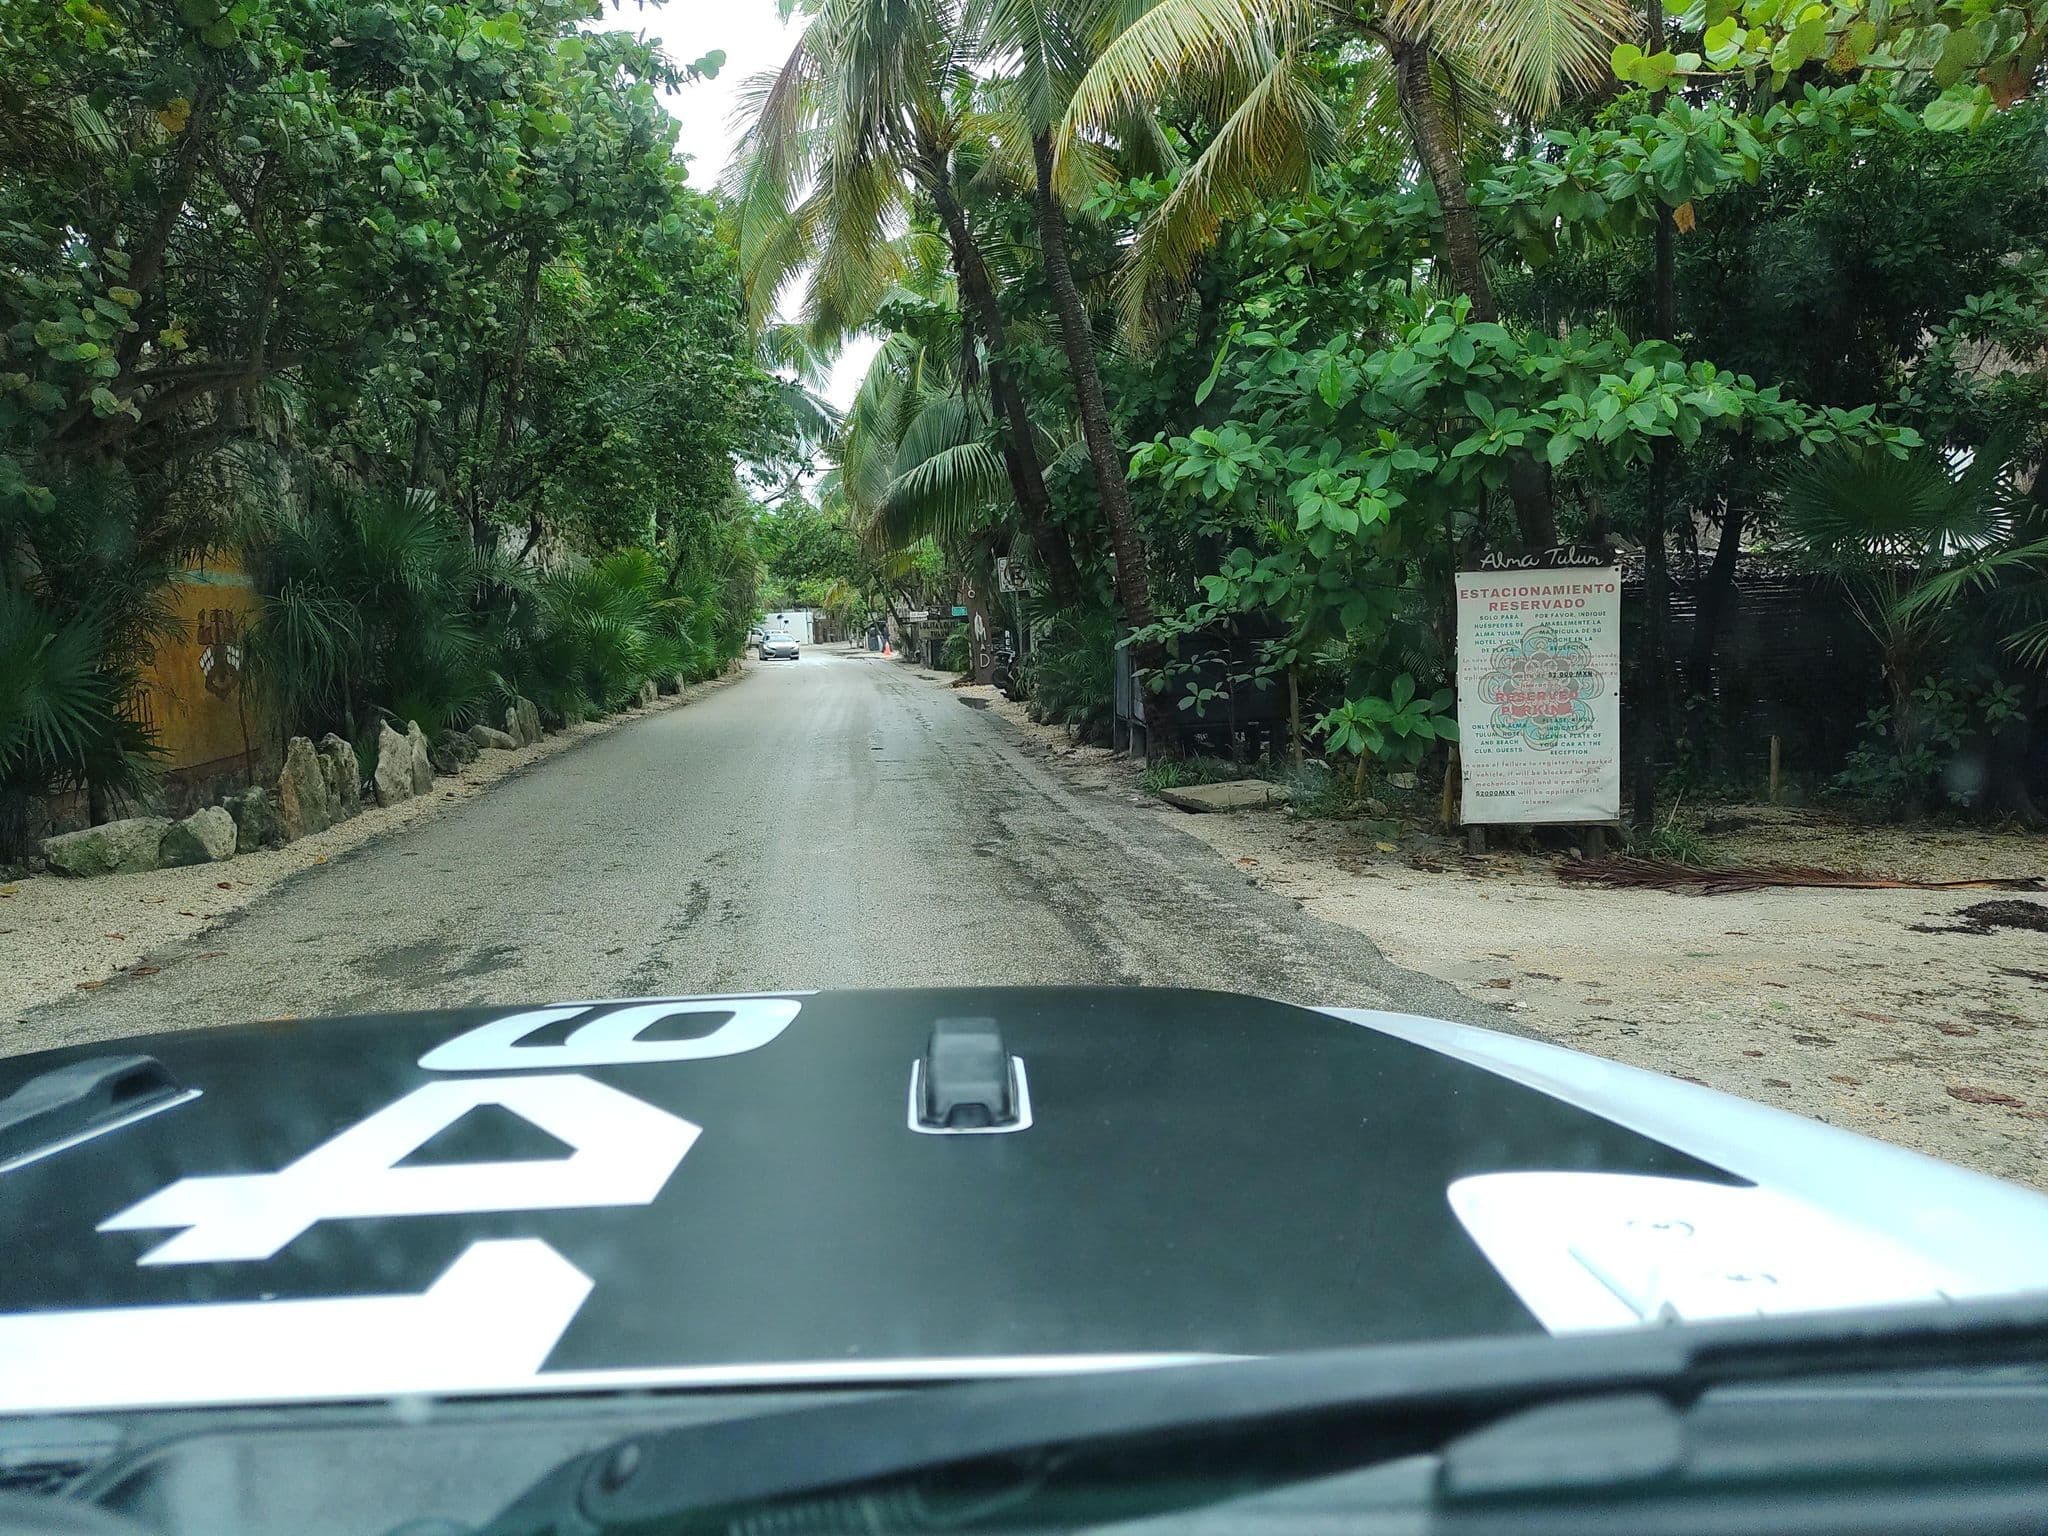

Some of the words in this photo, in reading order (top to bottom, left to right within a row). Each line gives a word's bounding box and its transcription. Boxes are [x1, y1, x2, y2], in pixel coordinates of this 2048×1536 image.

[1480, 551, 1540, 569] Alma
[1545, 545, 1604, 567] Tulum
[1460, 583, 1616, 600] ESTACIONAMIENTO
[1488, 598, 1587, 612] RESERVADO
[1475, 779, 1518, 788] mechanical
